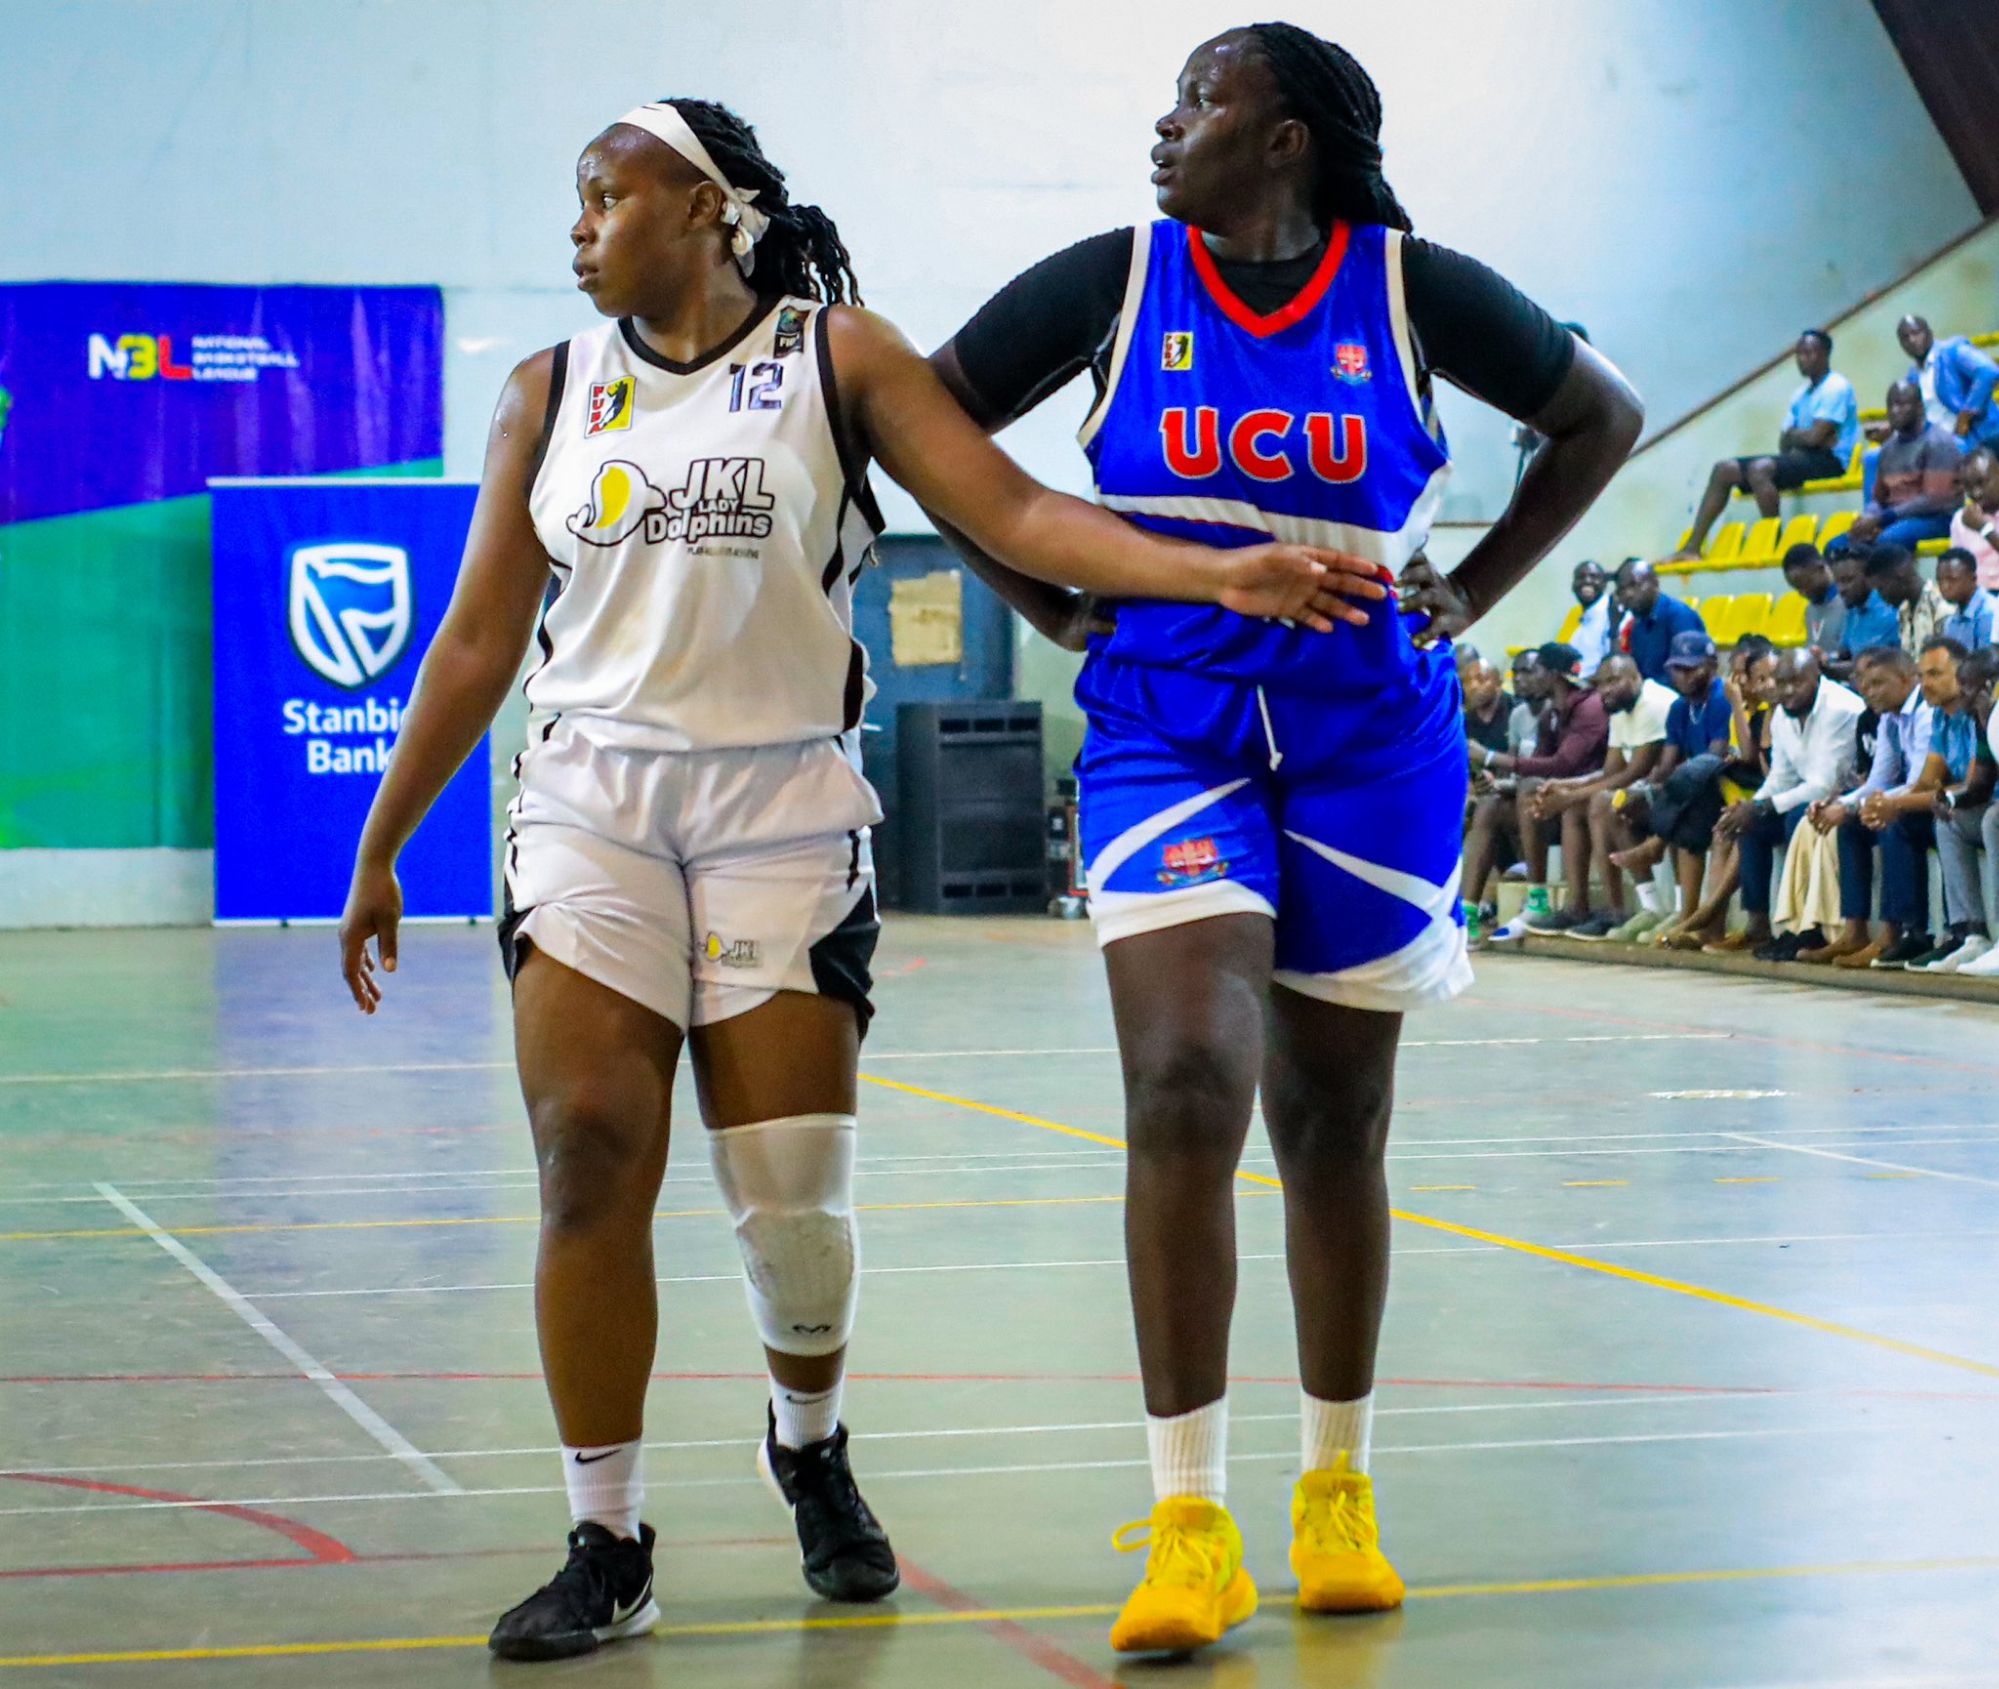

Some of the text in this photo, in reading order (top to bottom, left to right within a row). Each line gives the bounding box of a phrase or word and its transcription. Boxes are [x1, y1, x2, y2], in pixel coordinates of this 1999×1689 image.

[729, 362, 784, 412] 12
[1158, 405, 1368, 485] UCU
[669, 457, 775, 511] JKL
[698, 499, 739, 513] LADY
[645, 508, 773, 544] Dolphins
